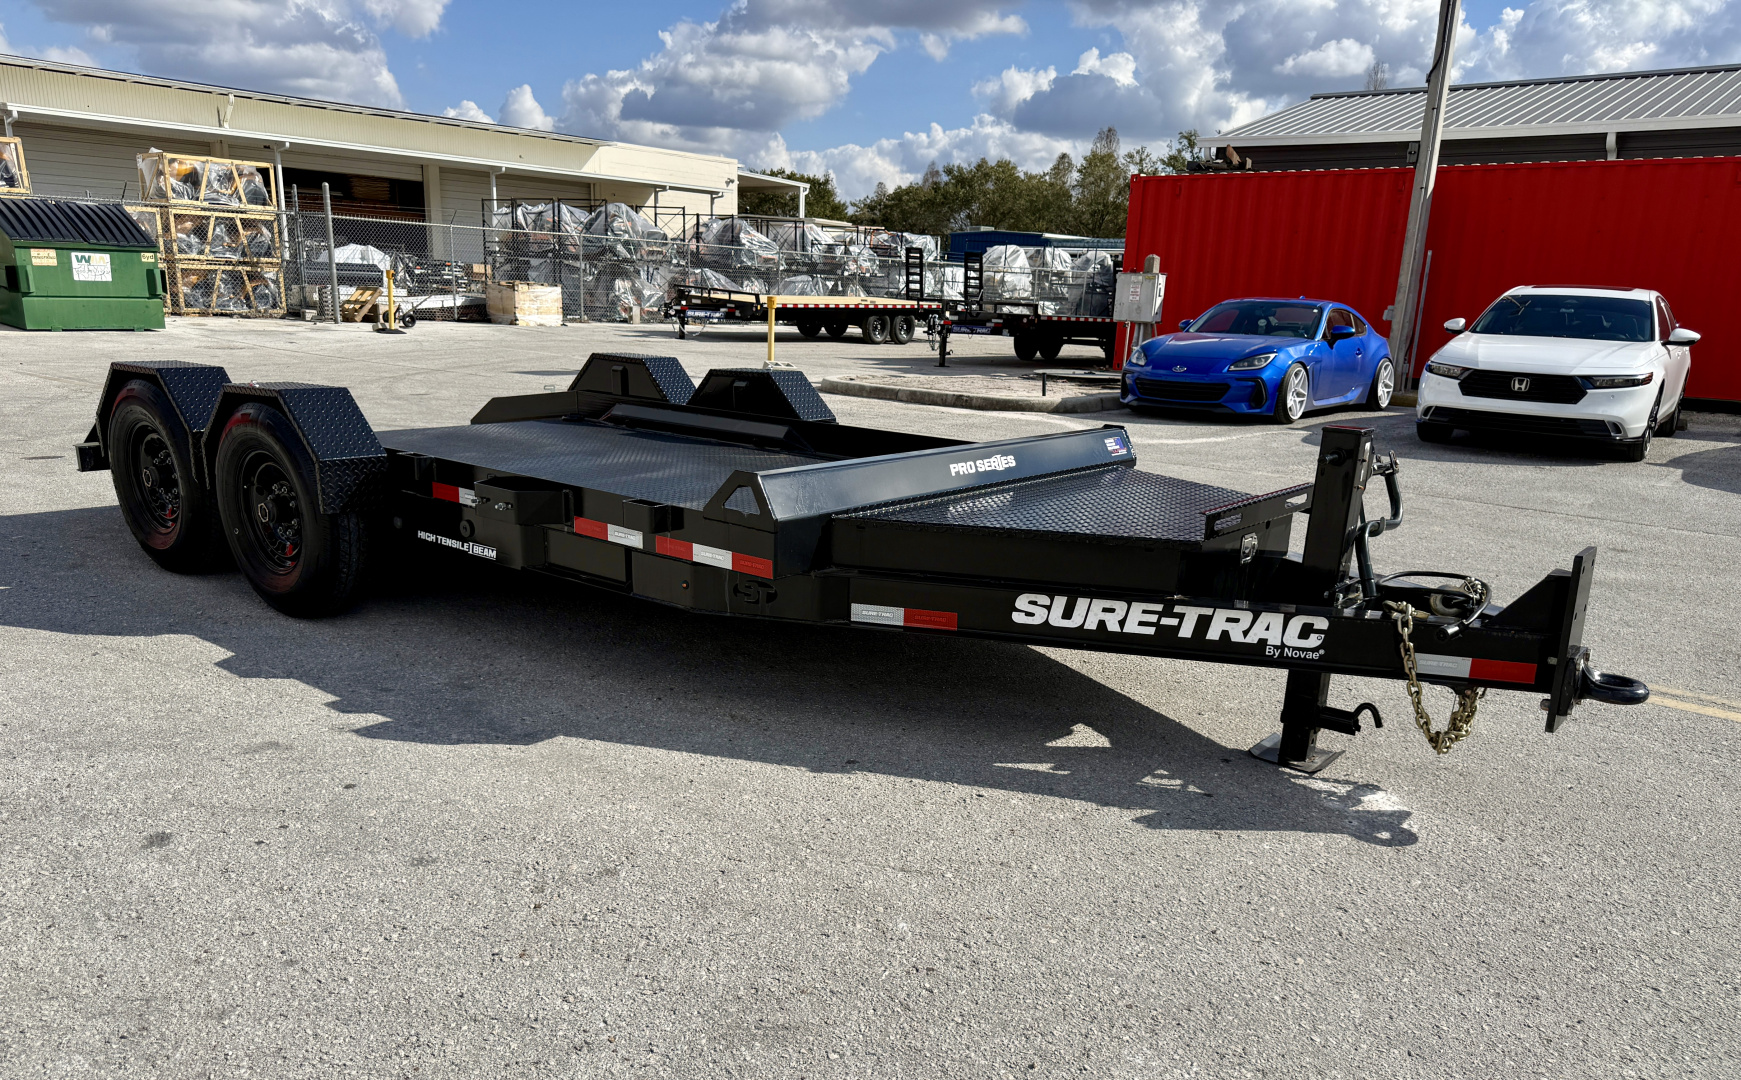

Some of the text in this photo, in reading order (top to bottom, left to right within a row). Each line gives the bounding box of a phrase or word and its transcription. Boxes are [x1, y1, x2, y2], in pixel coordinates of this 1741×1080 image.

[949, 454, 1017, 476] PRO SERIES
[417, 530, 436, 543] HIGH
[436, 535, 469, 552] TENSILE
[473, 545, 497, 559] BEAM
[1265, 645, 1281, 659] By
